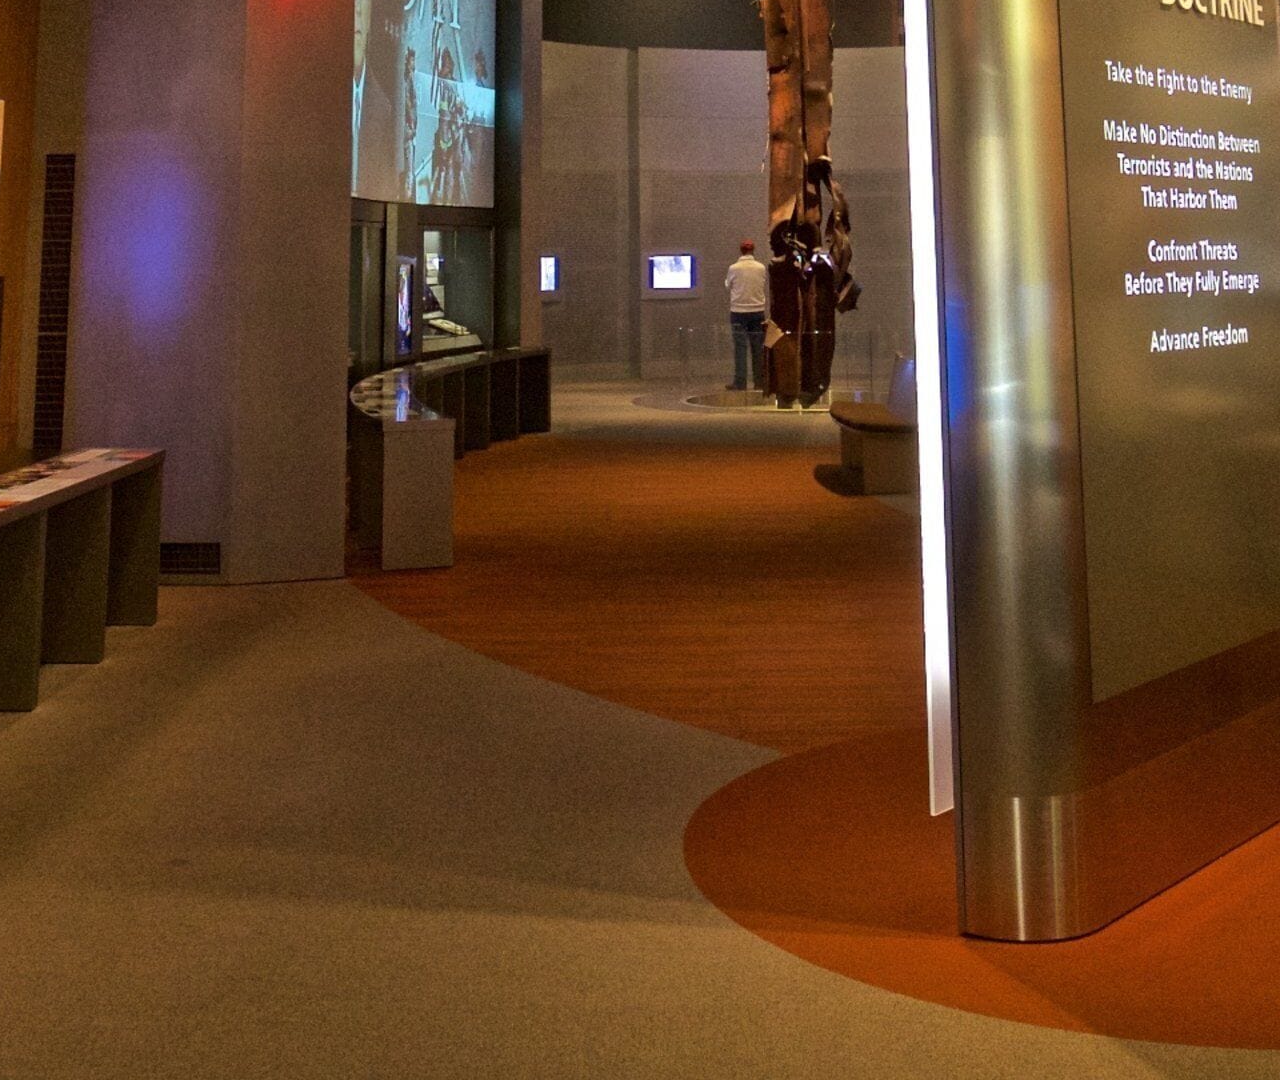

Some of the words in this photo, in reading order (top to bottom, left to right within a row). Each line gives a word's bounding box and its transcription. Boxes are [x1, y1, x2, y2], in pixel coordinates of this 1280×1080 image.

[1105, 60, 1132, 85] Take
[1135, 64, 1154, 87] the
[1157, 68, 1185, 96] Fight
[1187, 73, 1199, 93] to
[1201, 75, 1218, 97] the
[1220, 77, 1252, 104] Enemy
[1103, 119, 1138, 144] Make
[1140, 124, 1157, 145] No
[1159, 125, 1216, 151] Distinction
[1218, 130, 1260, 154] Between
[1117, 152, 1171, 178] Terrorists
[1173, 156, 1194, 179] and
[1196, 158, 1214, 179] the
[1215, 159, 1253, 181] Nations
[1141, 186, 1167, 208] That
[1169, 186, 1206, 209] Harbor
[1209, 187, 1237, 210] Them
[1147, 239, 1198, 262] Confront
[1199, 239, 1238, 261] Threats
[1124, 273, 1164, 297] Before
[1165, 272, 1193, 298] They
[1195, 269, 1220, 296] Fully
[1222, 268, 1260, 294] Emerge
[1150, 326, 1200, 353] Advance
[1202, 322, 1248, 348] Freedom
